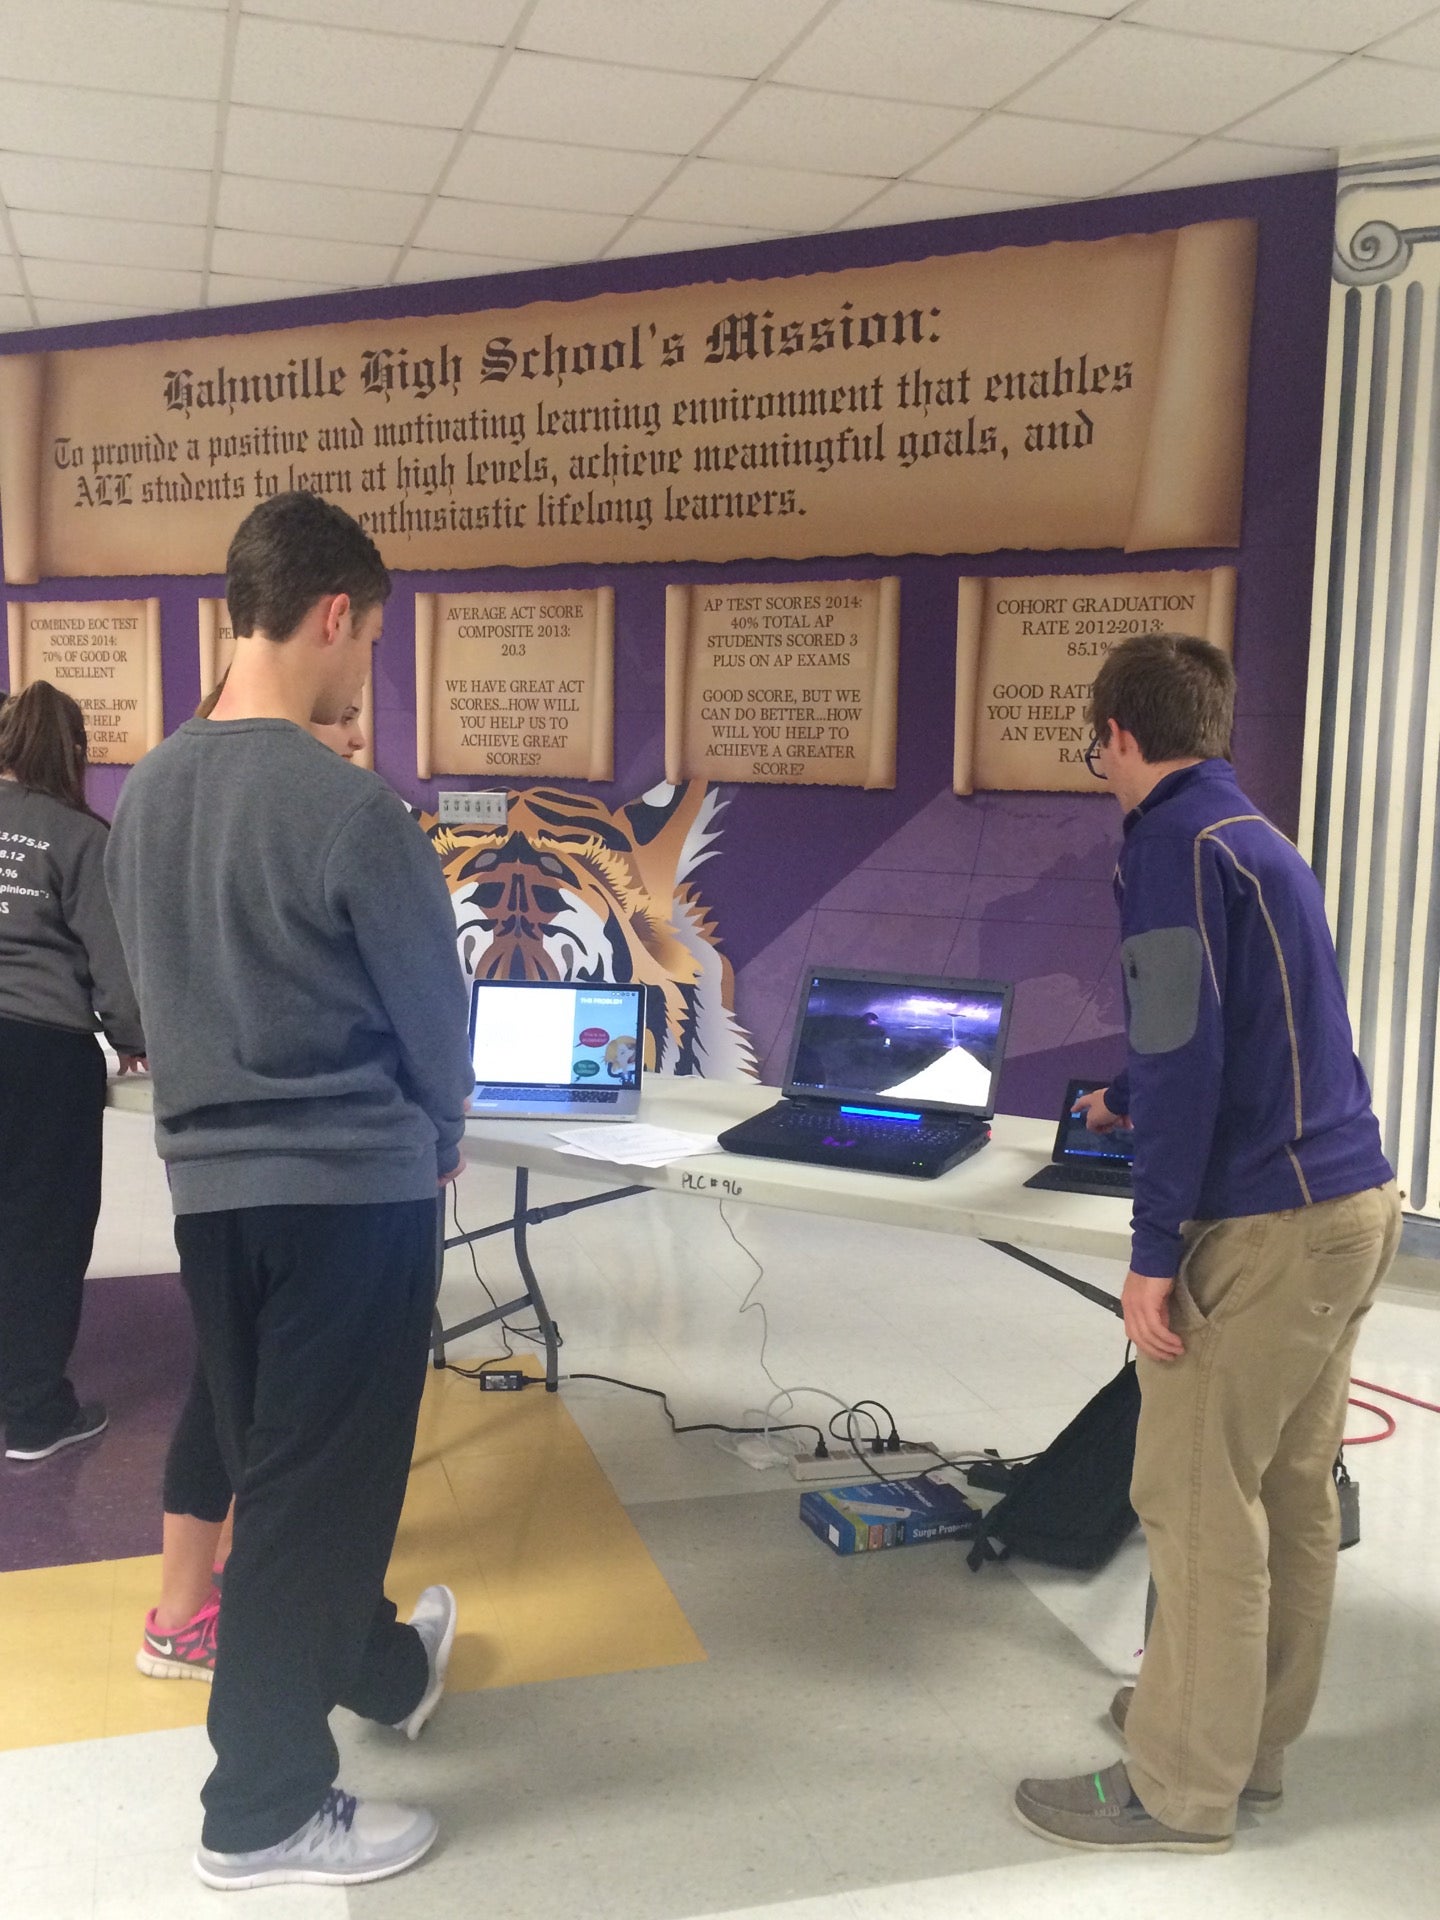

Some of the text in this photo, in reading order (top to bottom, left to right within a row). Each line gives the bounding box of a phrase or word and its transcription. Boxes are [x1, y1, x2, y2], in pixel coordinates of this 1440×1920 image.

[164, 301, 941, 418] Hahnville High School's Mission:
[54, 353, 1133, 472] To provide a positive and motivating learning environment that enables
[73, 410, 1094, 507] ALL students to learn at high levels, achieve meaningful goals, and
[358, 485, 807, 541] enthusiastic lifelong learners.
[704, 595, 863, 612] AP TEST SCORES 2014:
[997, 595, 1196, 614] COHORT GRADUATION
[447, 605, 584, 621] AVERAGE ACT SCORE
[31, 618, 139, 631] COMBINED EOC TEST
[730, 614, 834, 630] 40% TOTAL AP
[1022, 620, 1069, 635] RATE
[458, 625, 571, 639] COMPOSITE 2013:
[50, 634, 117, 646] SCORES 2014:
[707, 633, 858, 648] STUDENTS SCORED 3
[42, 651, 128, 663] 70% OF GOOD OR
[501, 643, 526, 657] 20.3
[713, 653, 850, 668] PLUS ON AP EXAMS
[55, 666, 116, 679] EXCELLENT
[445, 680, 585, 693] WE HAVE GREAT ACT
[993, 684, 1043, 699] GOOD
[702, 689, 861, 704] GOOD SCORE, BUT WE
[77, 698, 138, 711] ORES...HOW
[543, 698, 580, 712] WILL
[701, 708, 730, 721] CAN
[735, 708, 756, 721] DO
[987, 706, 1021, 720] YOU
[1027, 706, 1075, 720] HELP
[93, 715, 121, 727] HELP
[460, 716, 569, 730] YOU HELP US TO
[93, 731, 128, 743] GREAT
[712, 726, 849, 740] WILL YOU HELP TO
[1000, 727, 1027, 741] AN
[1034, 727, 1082, 741] EVEN
[461, 734, 568, 748] ACHIEVE GREAT
[87, 746, 109, 758] RES?
[705, 744, 855, 759] ACHIEVE A GREATER
[486, 752, 542, 766] SCORES?
[752, 762, 805, 776] SCORE?
[912, 1528, 937, 1539] Surge
